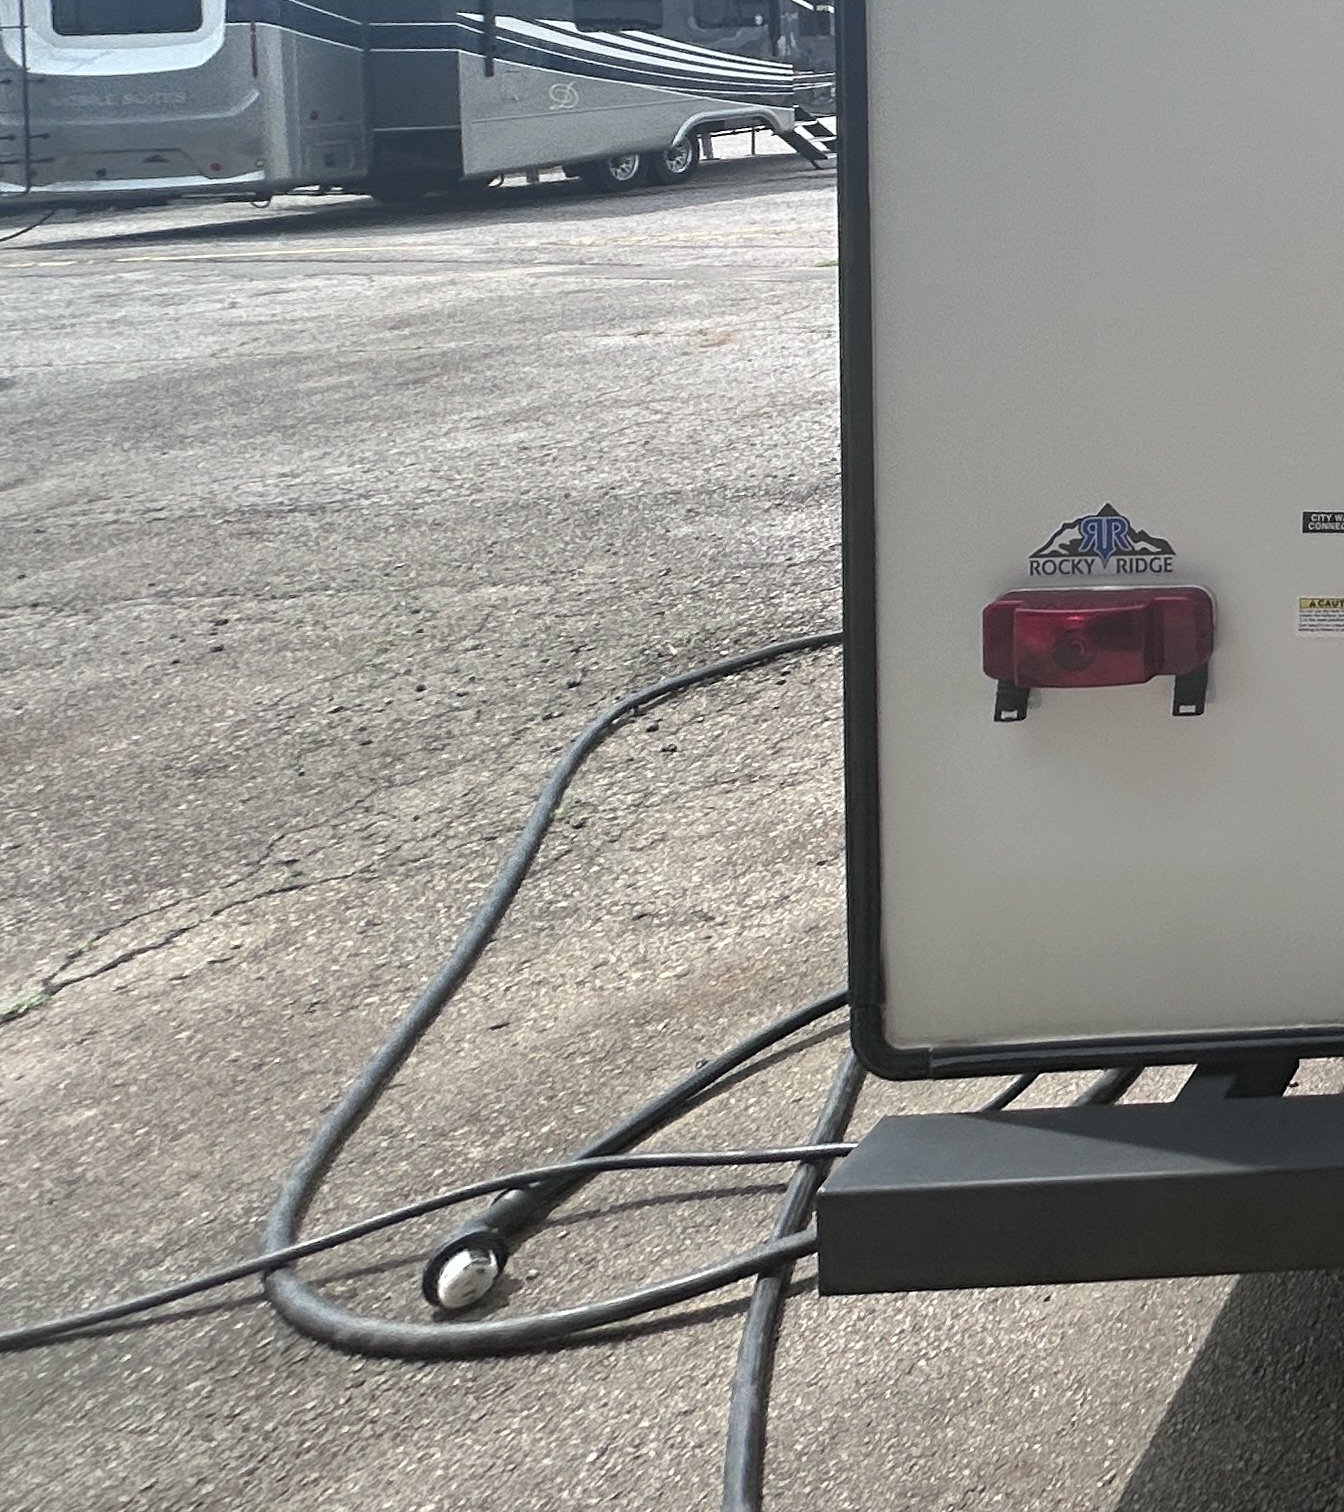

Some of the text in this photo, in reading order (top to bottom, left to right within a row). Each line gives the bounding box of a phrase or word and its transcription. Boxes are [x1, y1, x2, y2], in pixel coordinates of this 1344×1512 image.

[1310, 514, 1332, 522] CITY
[1029, 557, 1173, 576] ROCKY RIDGE
